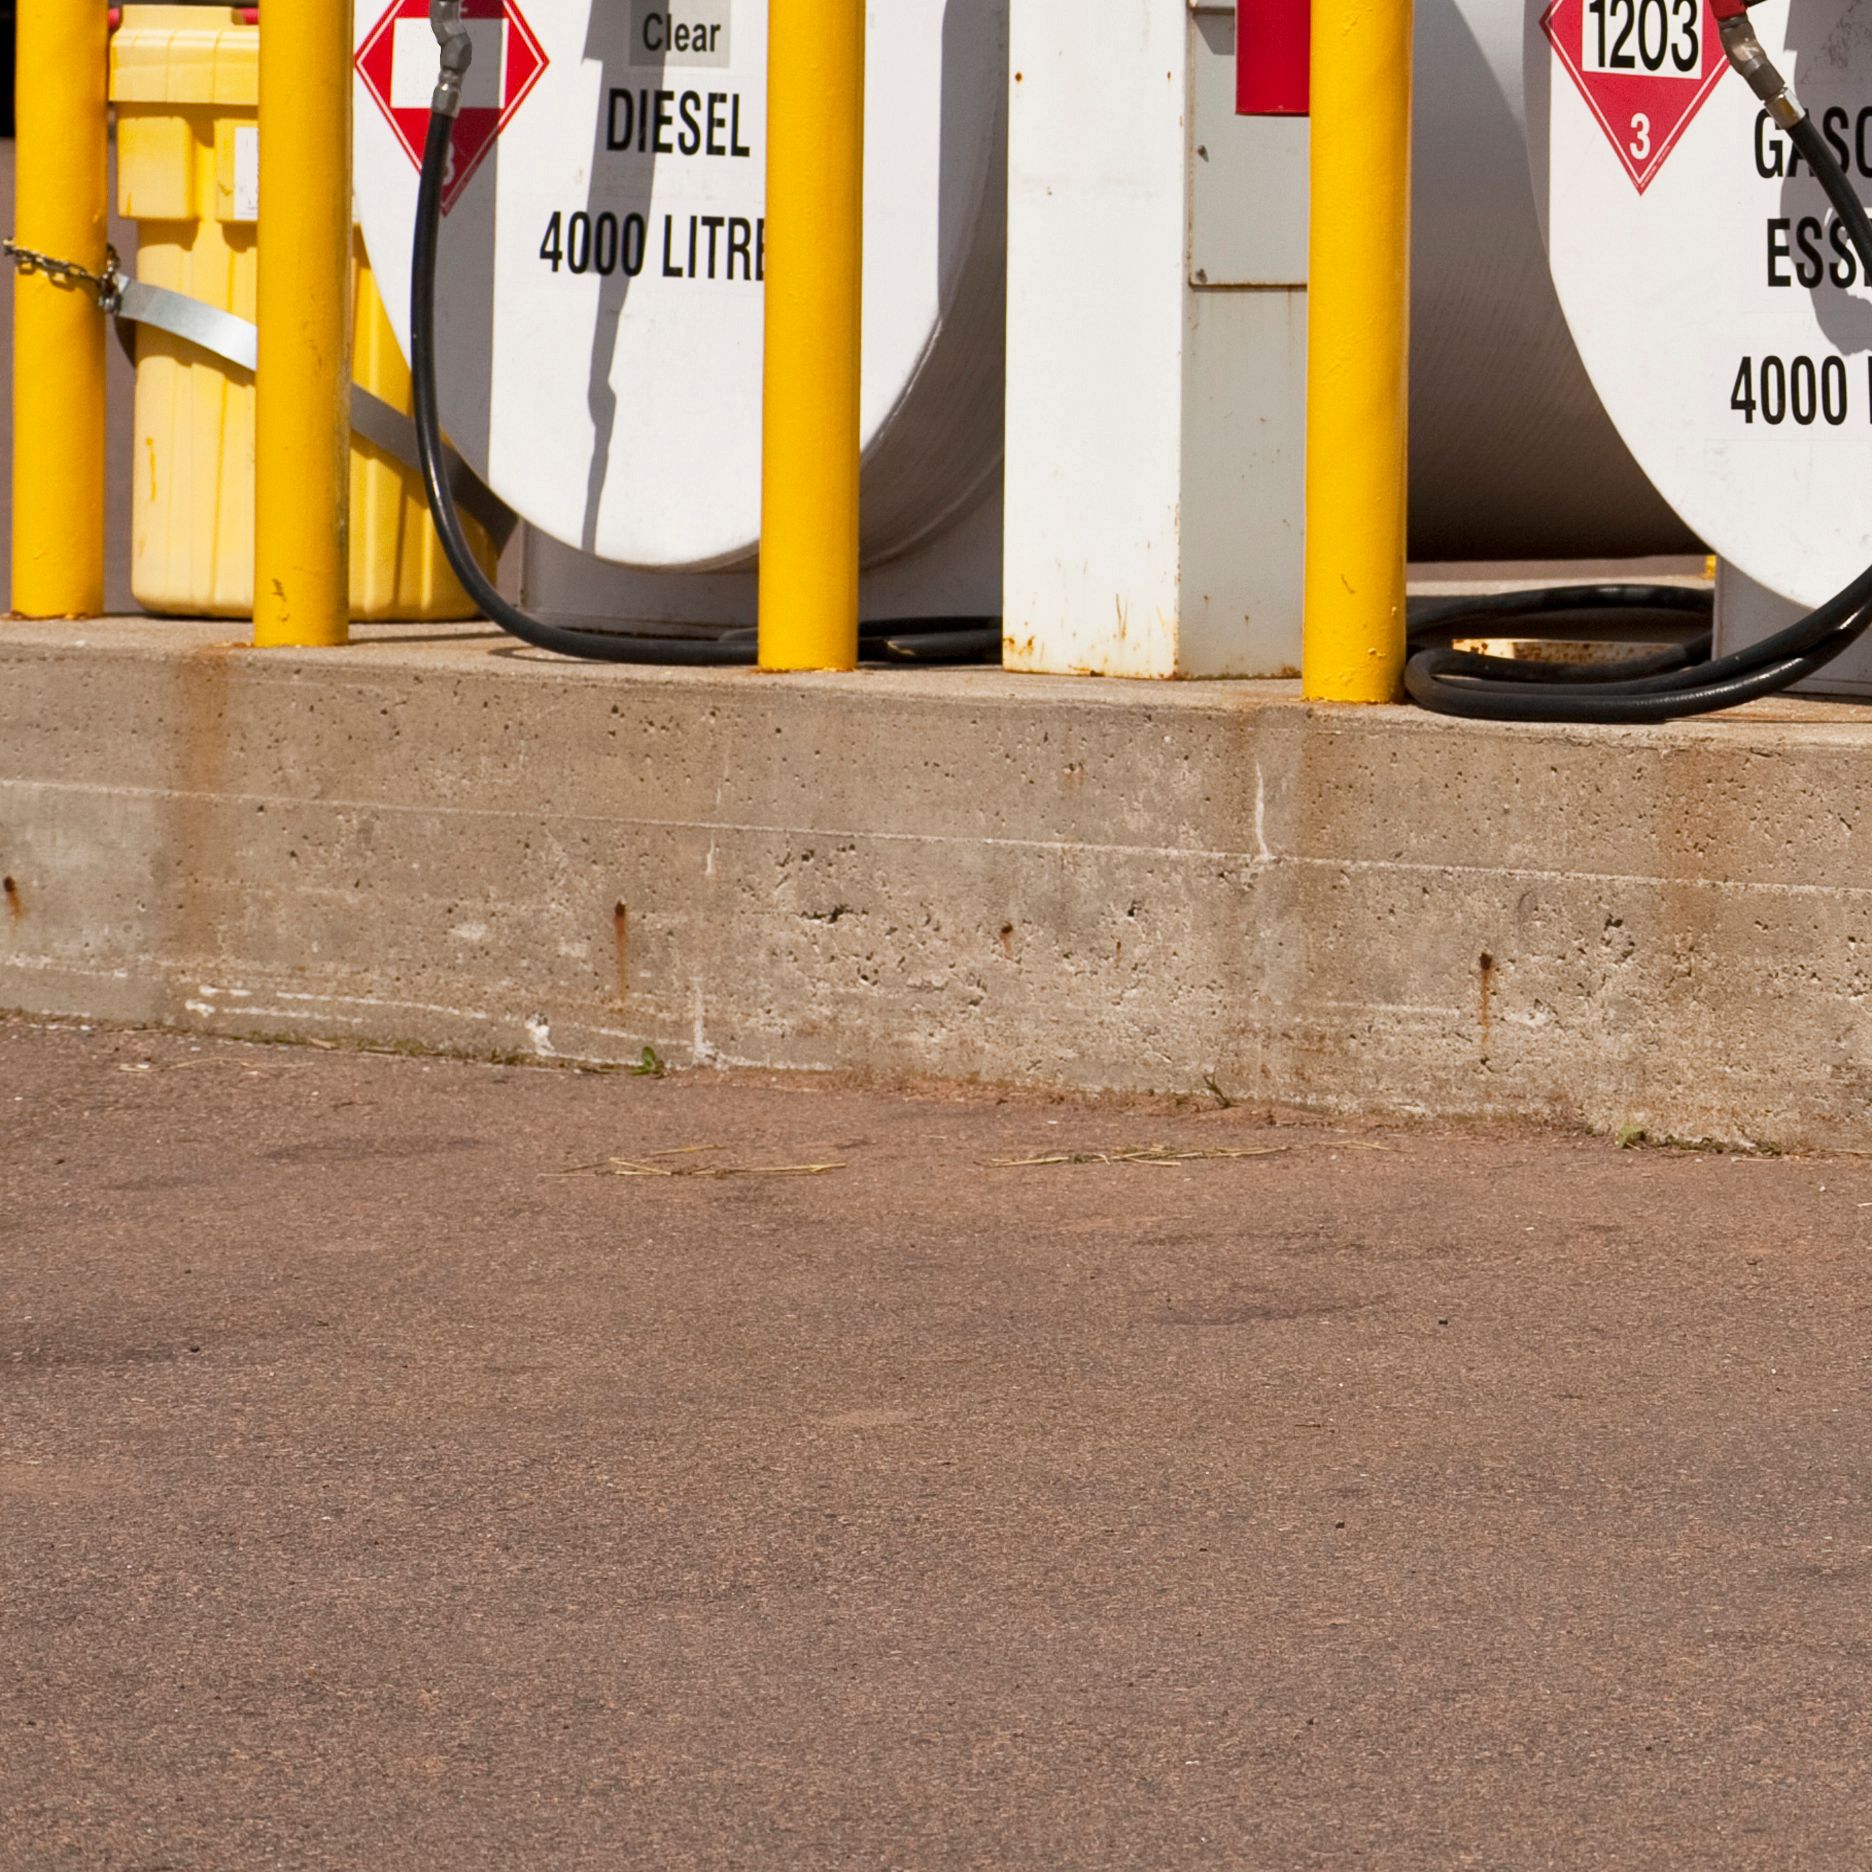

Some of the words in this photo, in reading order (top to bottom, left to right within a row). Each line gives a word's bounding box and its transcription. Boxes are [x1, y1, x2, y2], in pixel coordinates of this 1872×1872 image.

[642, 11, 721, 53] Clear
[606, 87, 750, 157] DIESEL
[1630, 112, 1651, 160] 3
[540, 210, 645, 278] 4000
[1731, 354, 1848, 426] 4000
